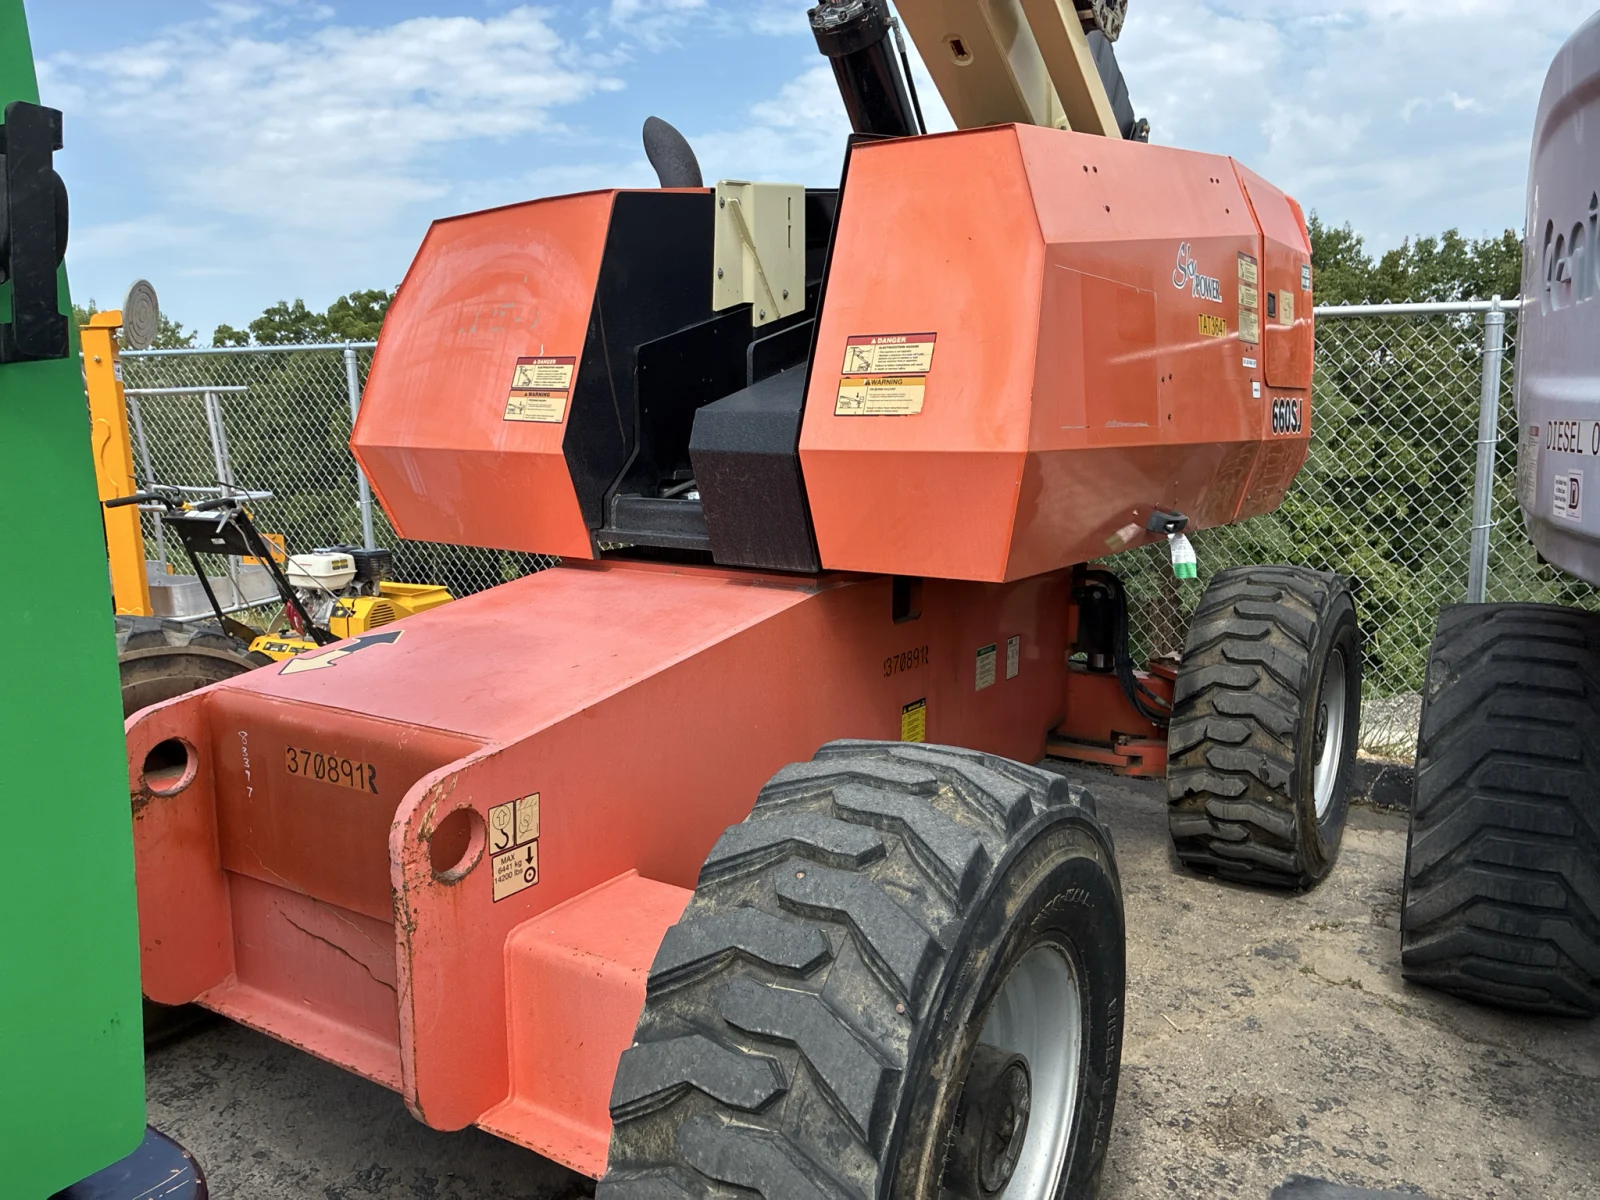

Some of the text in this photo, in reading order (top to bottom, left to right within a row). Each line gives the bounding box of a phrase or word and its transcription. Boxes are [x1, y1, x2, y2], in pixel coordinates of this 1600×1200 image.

[1173, 242, 1197, 298] Sky
[1195, 274, 1222, 303] POWER
[1199, 314, 1226, 337] TAT3647
[1272, 398, 1303, 435] 660SJ
[1547, 421, 1583, 454] DIESEL
[498, 860, 522, 875] 6441 kg
[501, 853, 515, 865] MAX
[494, 868, 523, 884] 14200 lbs
